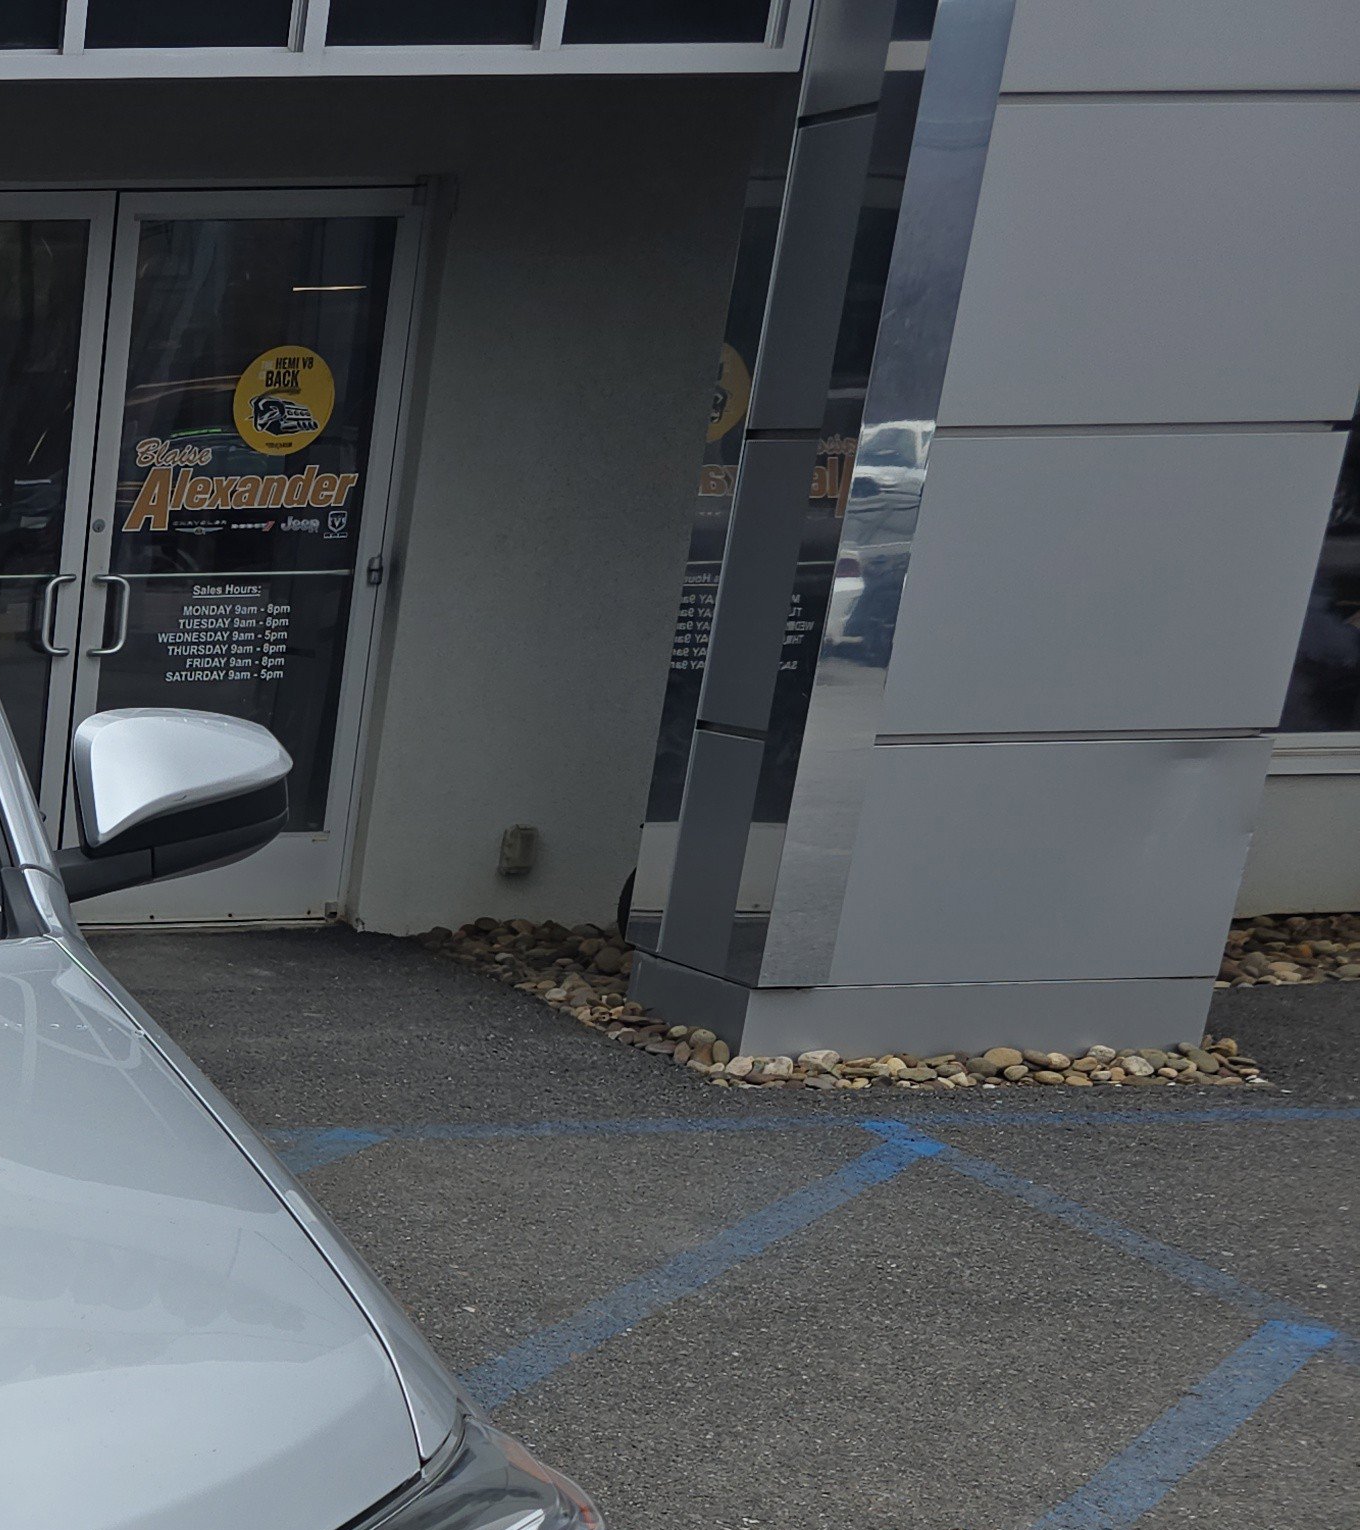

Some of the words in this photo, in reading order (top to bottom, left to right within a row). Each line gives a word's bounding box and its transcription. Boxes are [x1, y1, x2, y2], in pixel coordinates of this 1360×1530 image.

[275, 357, 299, 370] HEMI
[302, 357, 314, 370] V8
[265, 369, 300, 387] BACK
[136, 438, 212, 467] Blaise
[122, 465, 358, 532] Alexander
[281, 516, 320, 534] Jeep
[192, 585, 222, 595] Sales
[225, 584, 261, 594] Hours:
[183, 605, 232, 616] MONDAY
[234, 605, 258, 615] 9am
[267, 604, 291, 615] 8pm
[178, 618, 231, 629] TUESDAY
[233, 618, 256, 628] 9am
[265, 617, 289, 628] 8pm
[157, 631, 230, 643] WEDNESDAY
[232, 631, 255, 641] 9am
[264, 630, 288, 641] 5pm
[167, 644, 228, 656] THURSDAY
[231, 644, 253, 654] 9am
[263, 643, 286, 654] 8pm
[185, 657, 227, 669] FRIDAY
[229, 657, 252, 667] 9am
[261, 656, 285, 668] 8pm
[165, 670, 226, 682] SATURDAY
[228, 670, 250, 680] 9am
[260, 669, 284, 680] 5pm
